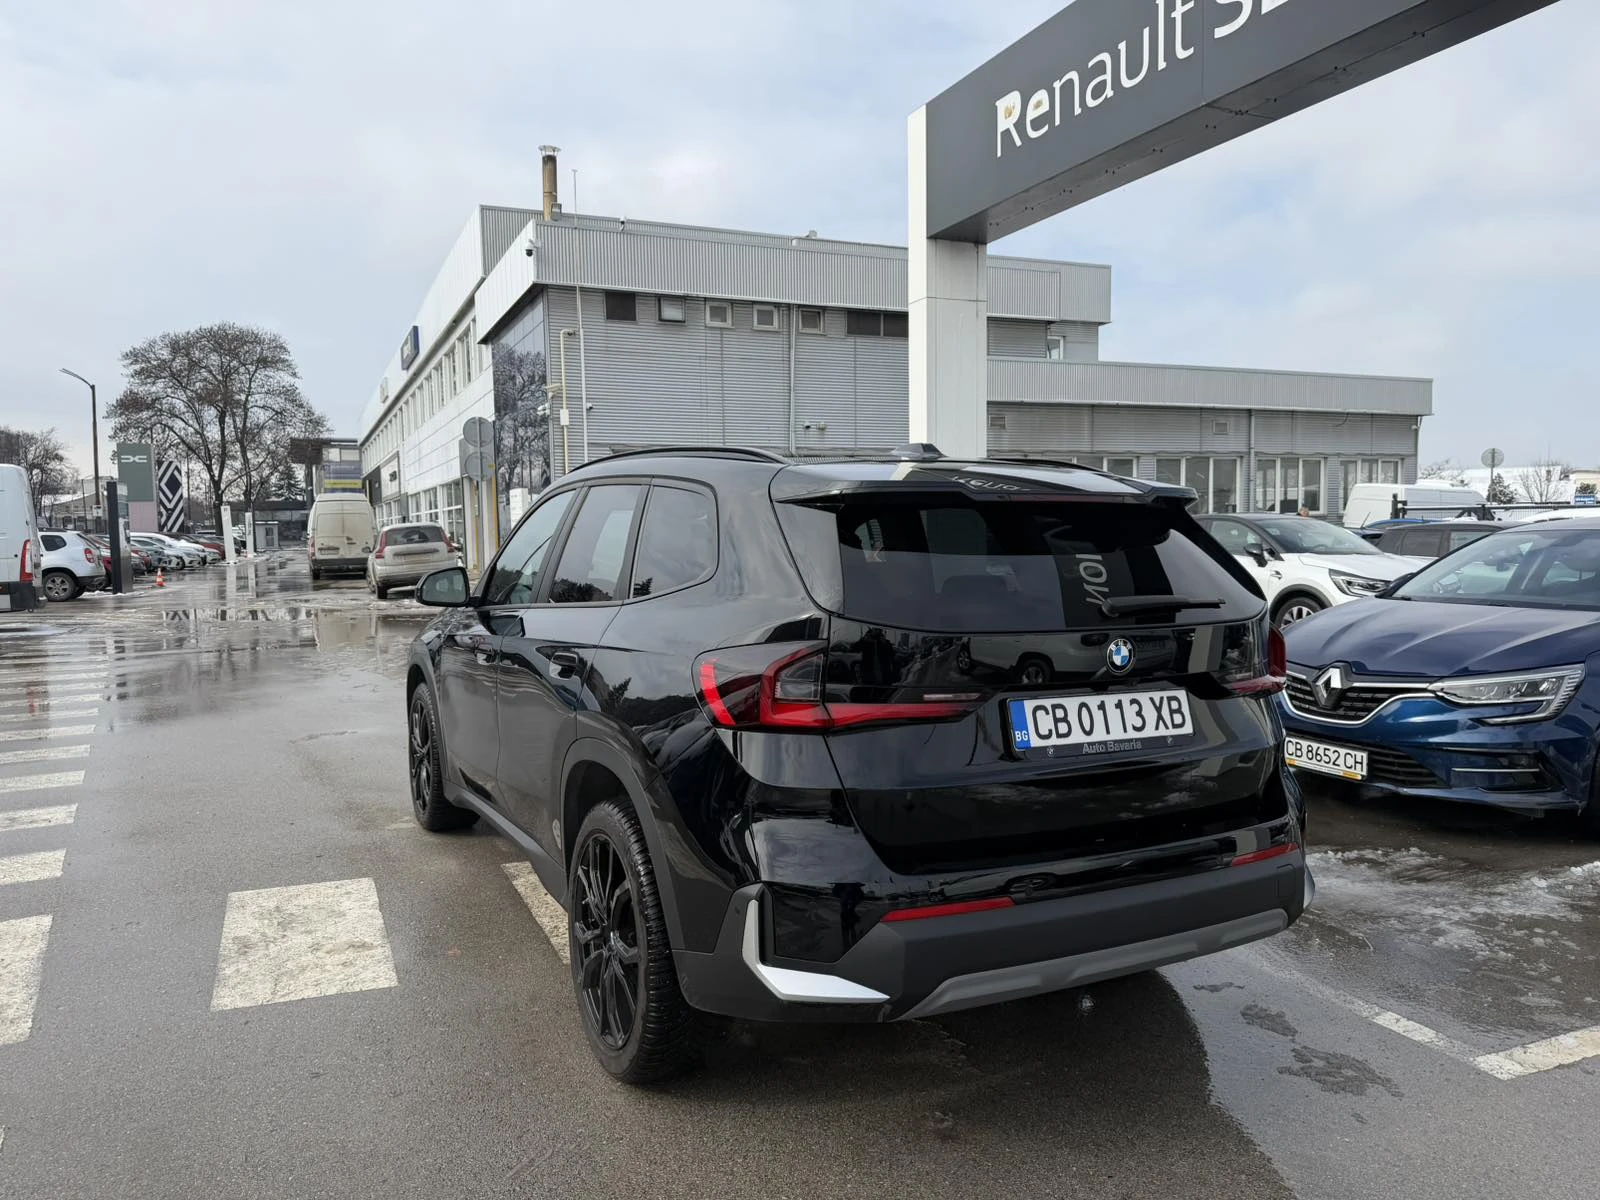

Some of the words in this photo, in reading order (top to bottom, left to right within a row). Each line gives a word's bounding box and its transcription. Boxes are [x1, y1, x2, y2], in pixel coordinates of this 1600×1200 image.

[996, 0, 1194, 158] Renault
[1032, 703, 1072, 740] CB
[1077, 698, 1147, 737] 0113
[1149, 695, 1186, 731] XB
[1016, 731, 1028, 742] BG
[1082, 743, 1105, 754] Auto
[1107, 739, 1142, 752] Bavaria
[1286, 740, 1303, 758] CB
[1306, 744, 1341, 766] 8652
[1344, 752, 1364, 772] CH
